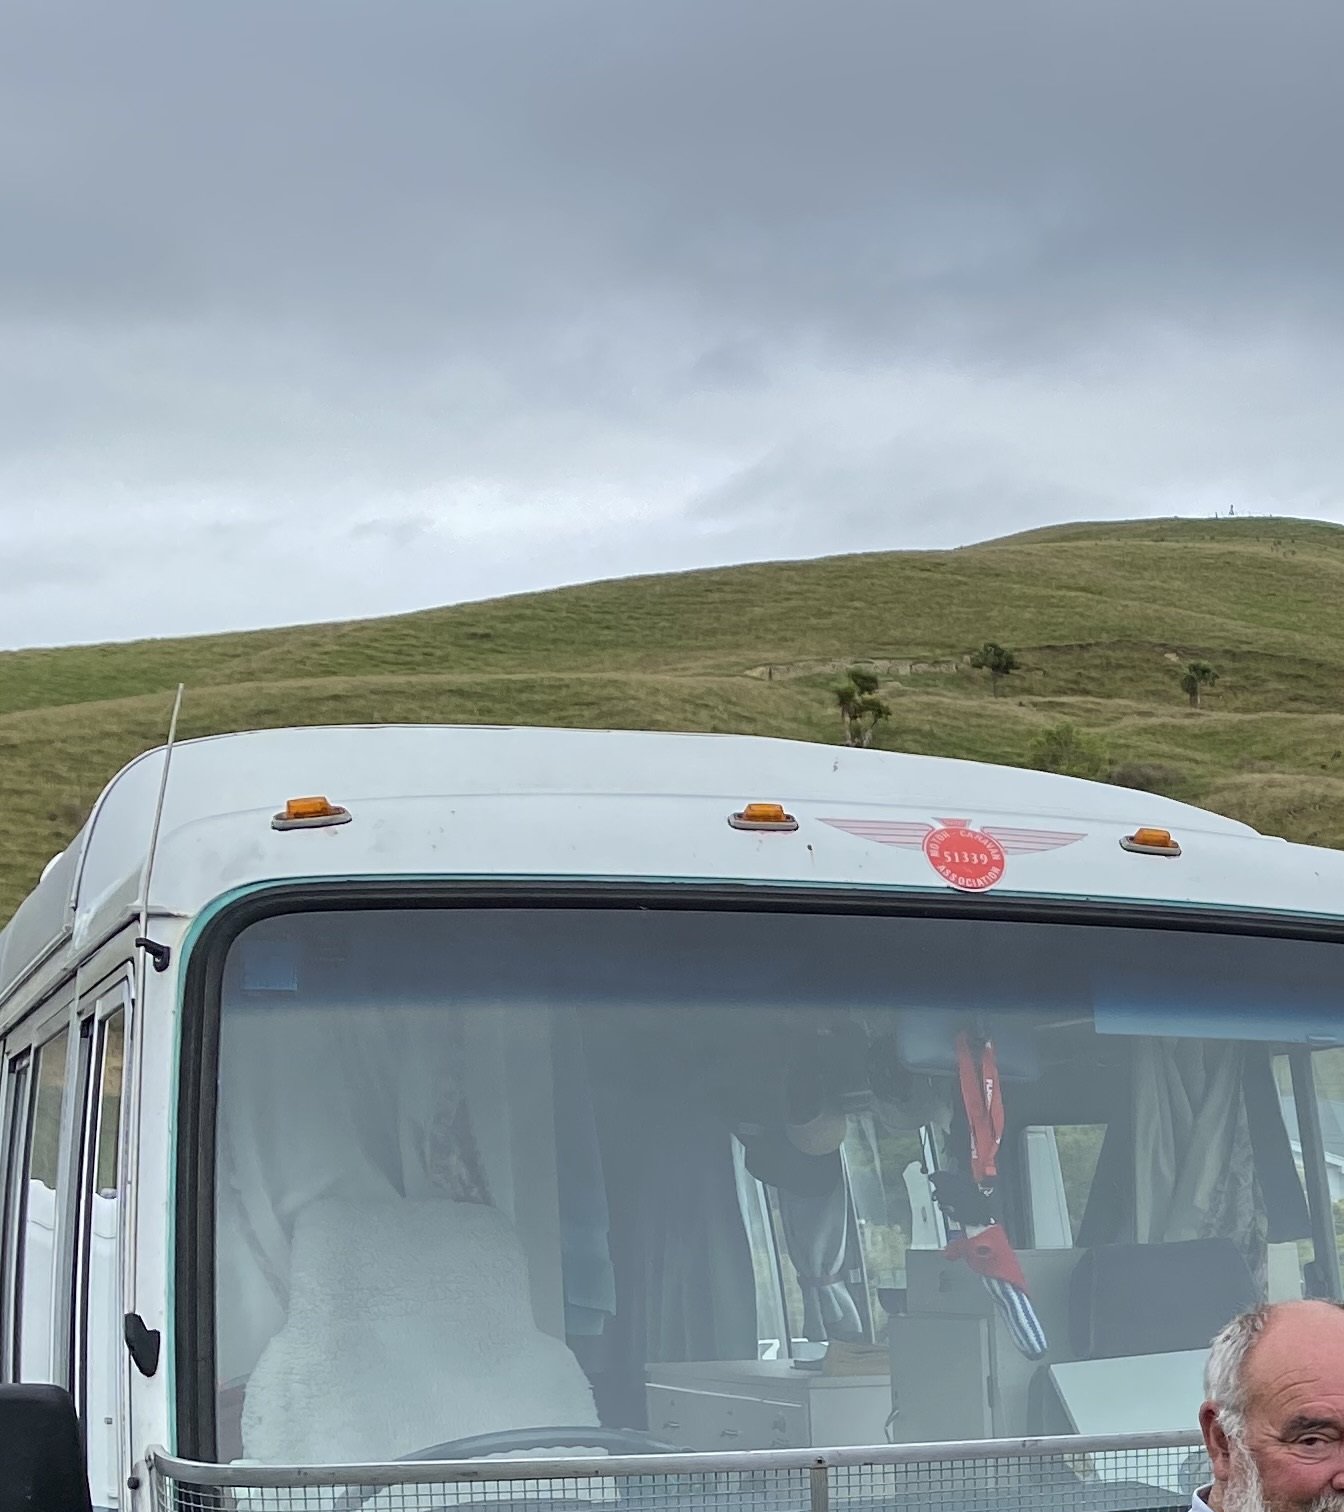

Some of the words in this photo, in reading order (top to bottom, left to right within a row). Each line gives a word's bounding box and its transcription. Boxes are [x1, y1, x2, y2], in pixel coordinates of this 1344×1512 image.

[929, 830, 950, 857] MOTOR
[959, 829, 1001, 860] CARAVAN
[943, 851, 989, 865] 51339
[937, 866, 1001, 887] ASSOCIATION
